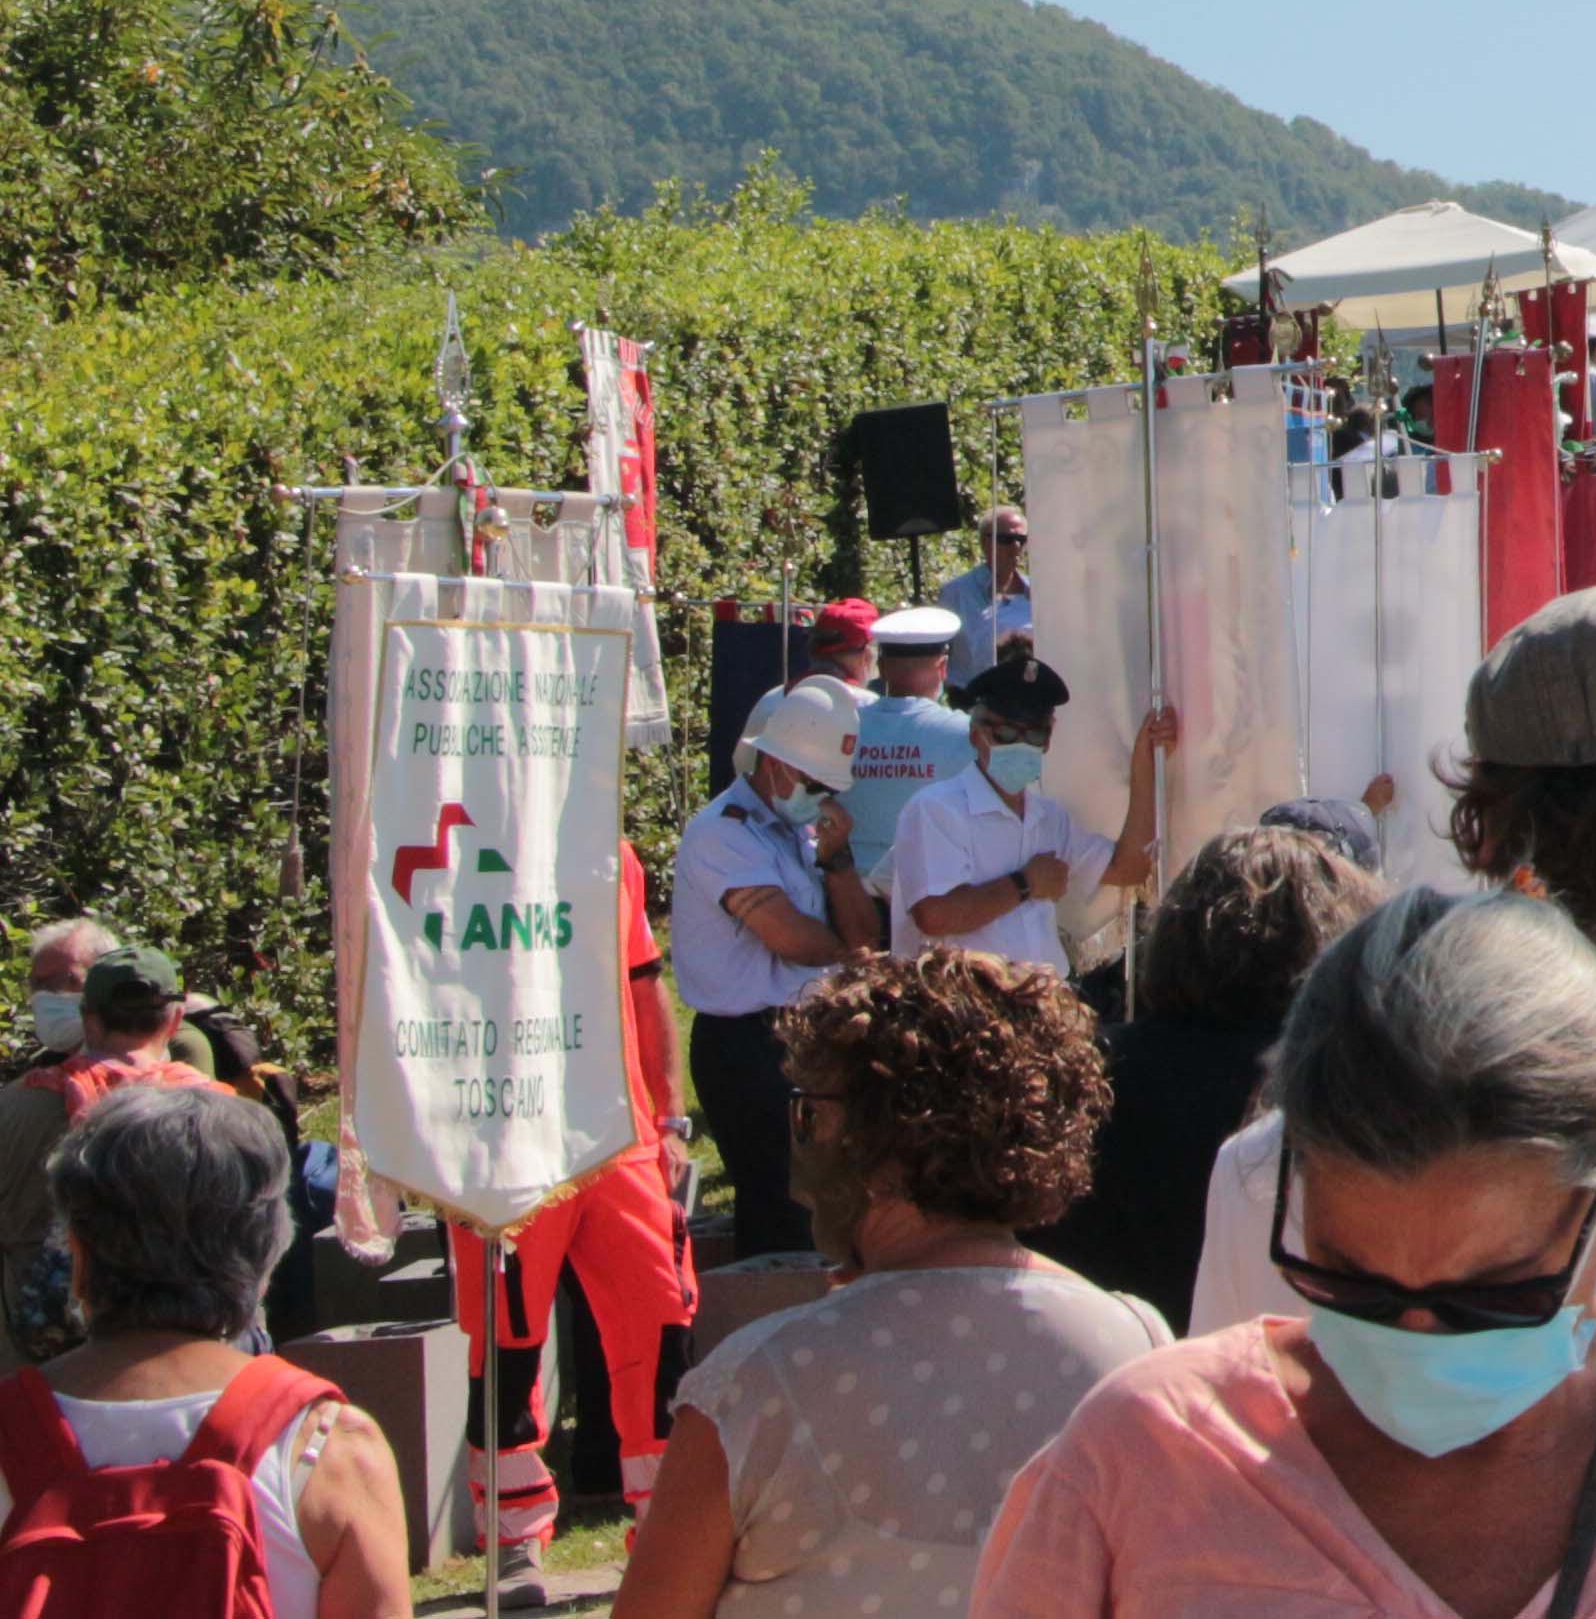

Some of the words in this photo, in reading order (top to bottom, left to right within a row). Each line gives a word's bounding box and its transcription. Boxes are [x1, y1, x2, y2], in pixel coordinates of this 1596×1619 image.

[859, 744, 921, 760] POLIZIA
[461, 901, 573, 951] ANPAS
[396, 1019, 498, 1058] COMITATO
[454, 1075, 545, 1121] TOSCANO
